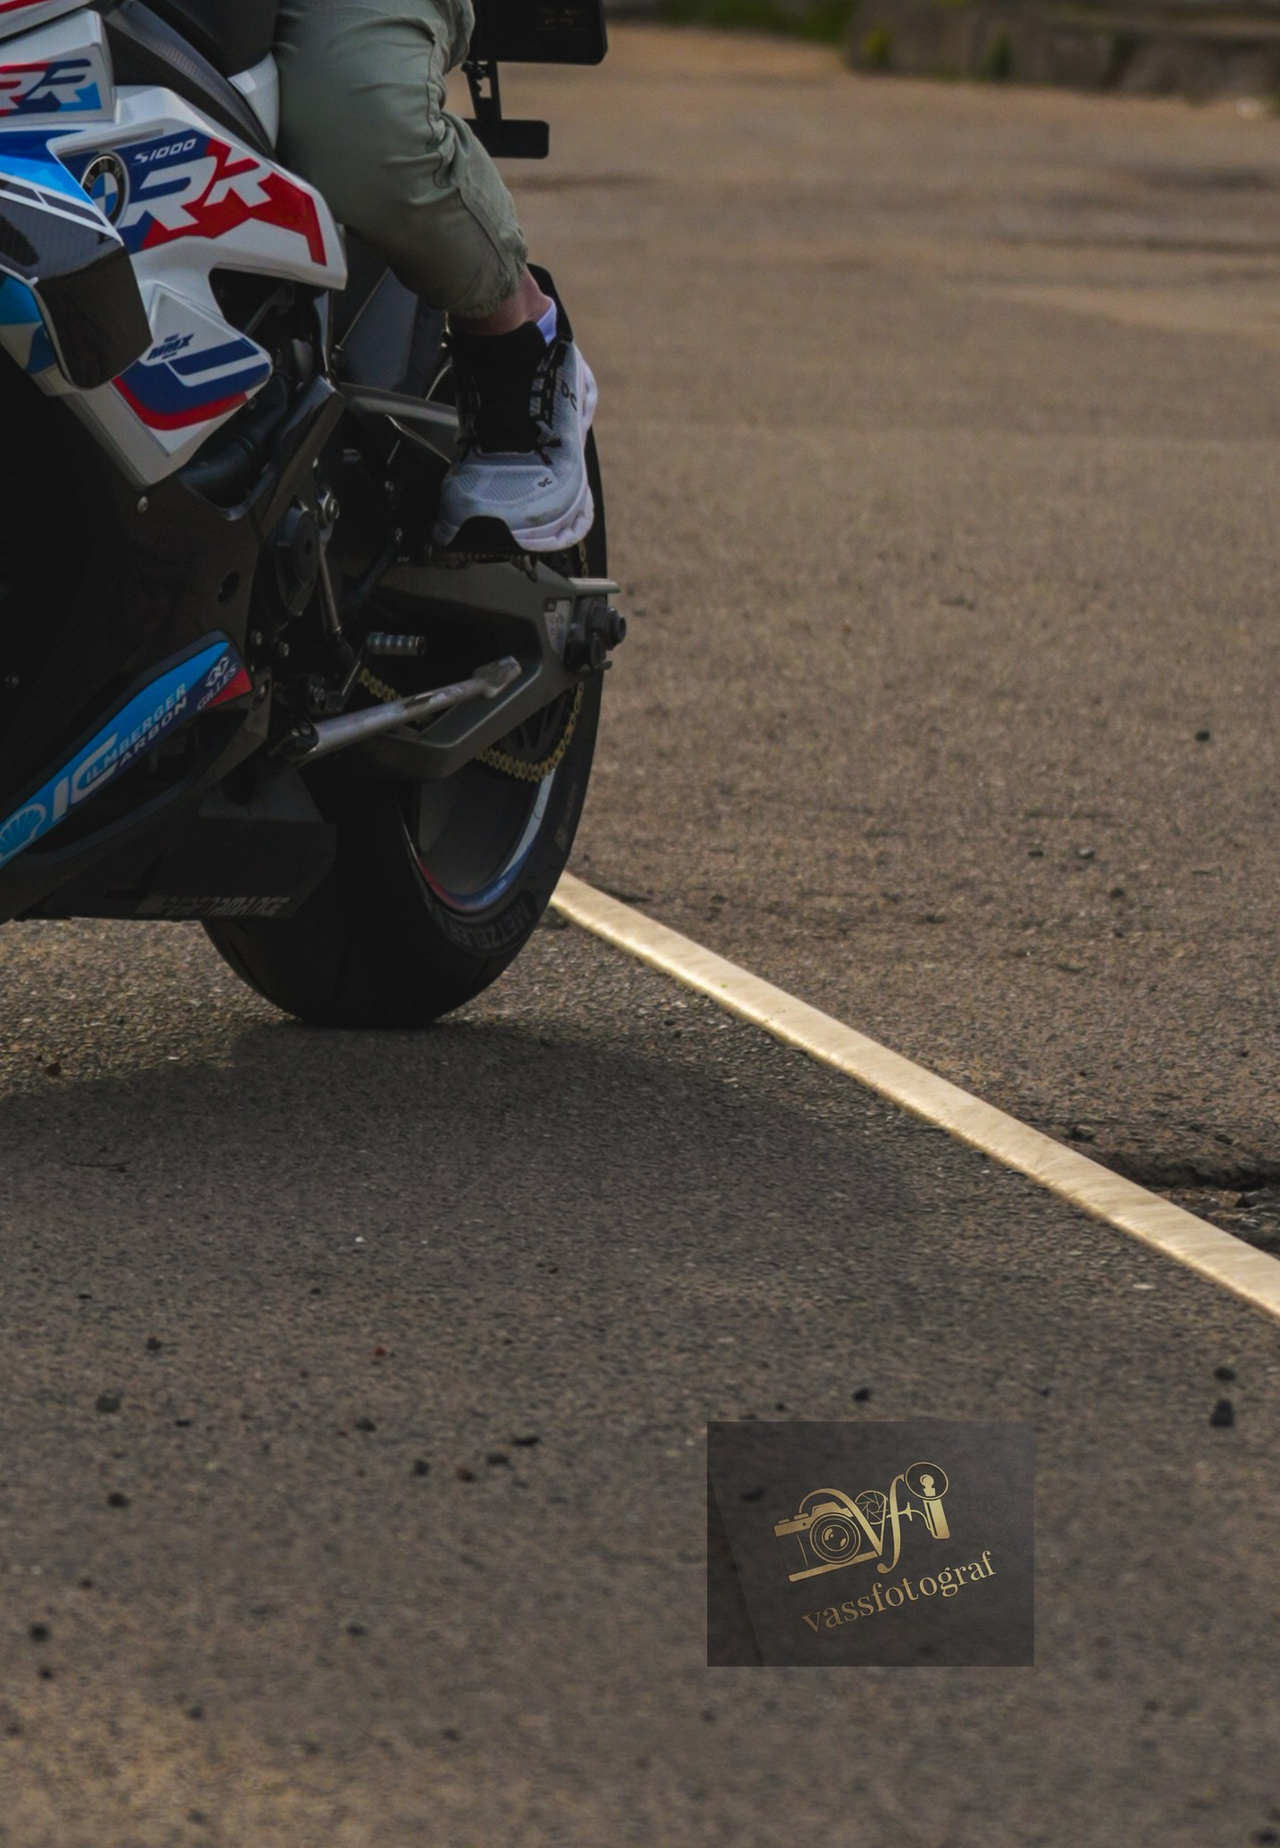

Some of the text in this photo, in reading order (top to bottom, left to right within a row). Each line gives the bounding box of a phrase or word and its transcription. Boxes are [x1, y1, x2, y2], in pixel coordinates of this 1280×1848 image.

[133, 138, 197, 164] S1000
[120, 150, 272, 231] RR
[197, 663, 237, 711] GILLES
[86, 683, 187, 784] ILMBERGER
